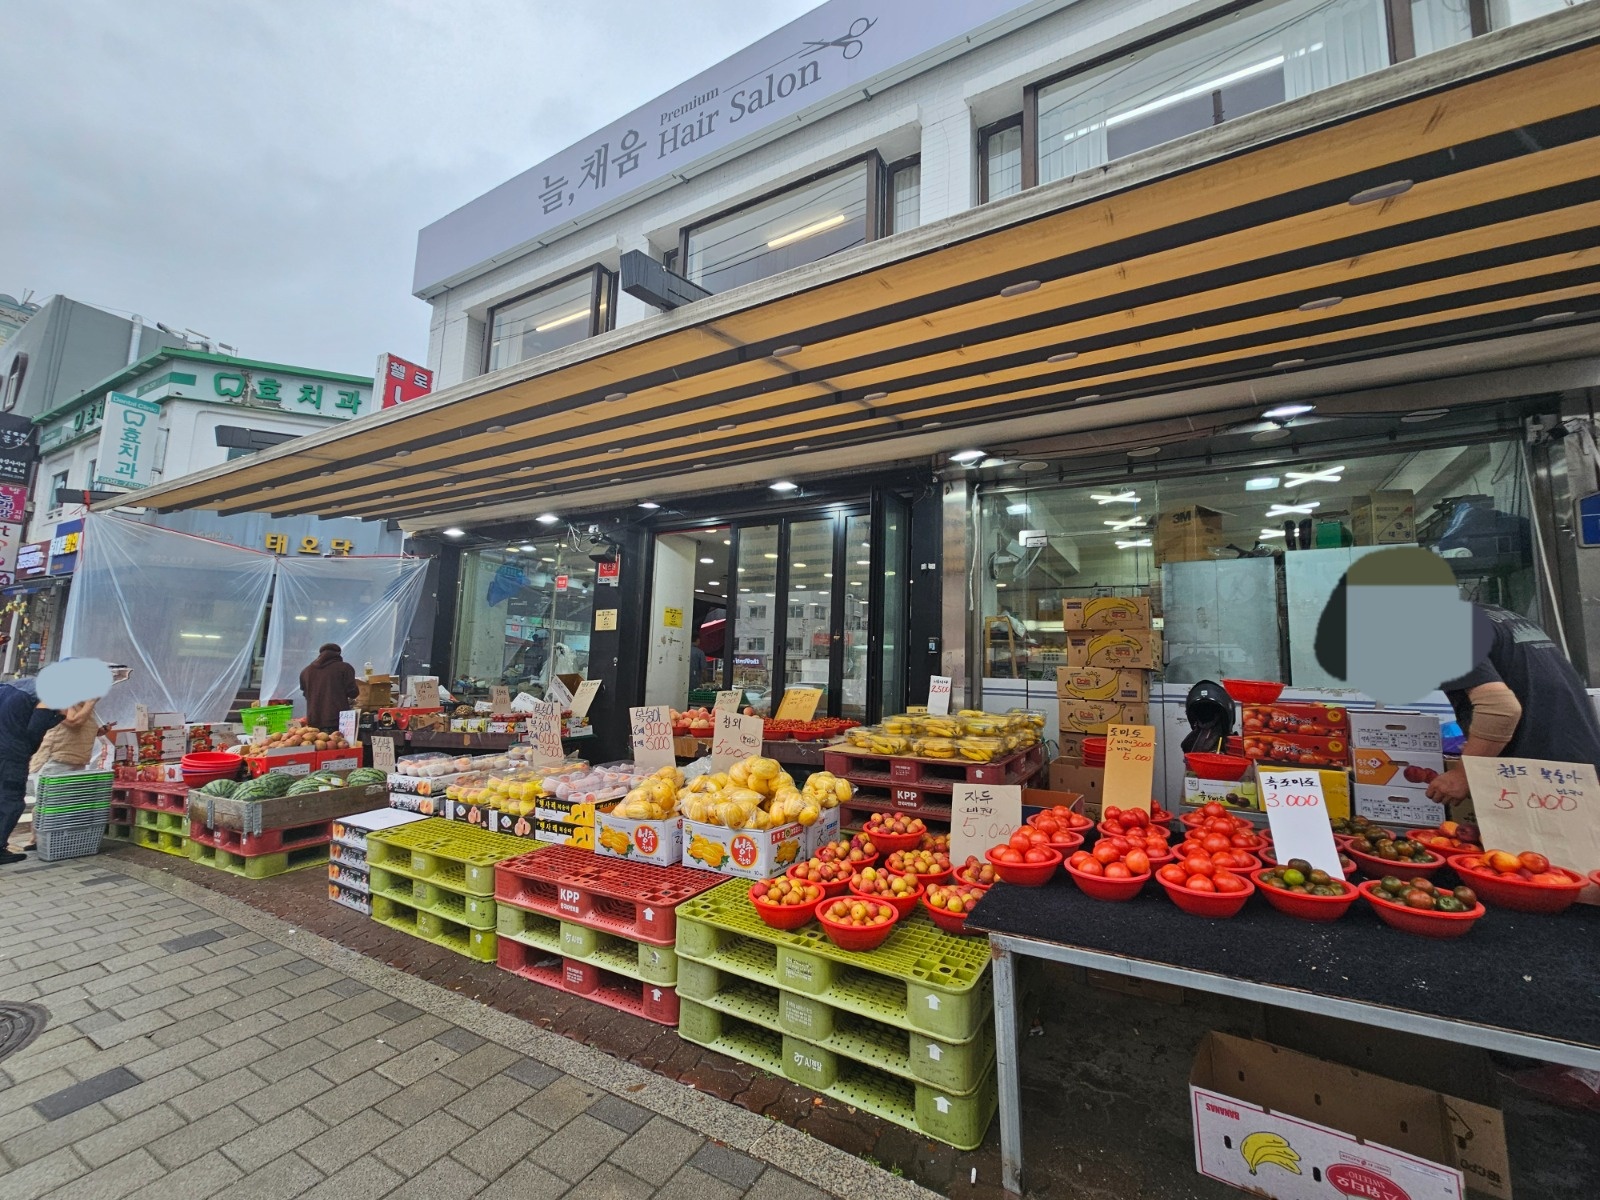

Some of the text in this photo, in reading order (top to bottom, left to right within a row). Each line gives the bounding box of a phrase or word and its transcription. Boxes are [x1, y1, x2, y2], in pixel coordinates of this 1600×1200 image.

[657, 60, 822, 160] Hair Salon
[660, 86, 720, 126] Premium
[113, 395, 137, 408] Dental
[254, 377, 363, 415] 효치과
[115, 427, 142, 480] 효치과
[1172, 510, 1192, 524] 3M
[1077, 677, 1091, 686] Dole
[635, 707, 662, 723] 복숭아
[723, 715, 741, 730] 참외
[1079, 710, 1095, 720] Dole
[1497, 763, 1583, 784] 천도 복숭아
[897, 790, 918, 801] KPP
[964, 790, 994, 805] 자두
[560, 888, 580, 903] KPP
[1205, 1103, 1240, 1121] BANANAS
[1348, 1171, 1386, 1189] SWEETIO
